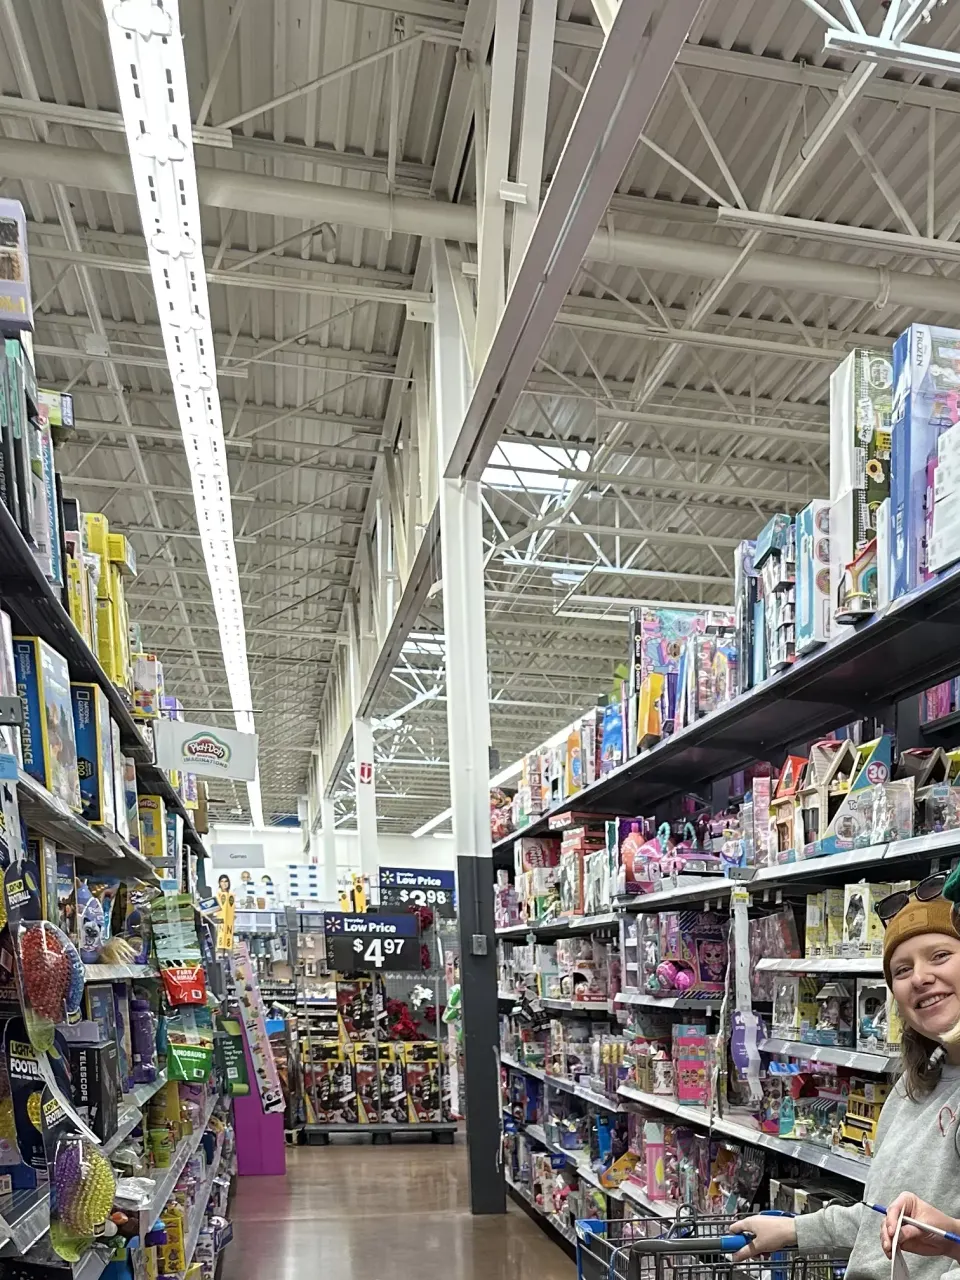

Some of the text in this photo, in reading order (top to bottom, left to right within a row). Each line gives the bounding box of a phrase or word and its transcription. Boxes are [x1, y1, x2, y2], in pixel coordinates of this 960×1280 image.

[20, 720, 34, 765] SCIENCE
[189, 742, 224, 757] Play-Doh
[183, 757, 228, 769] IMAGINATIONS
[867, 765, 888, 780] 30
[396, 876, 442, 886] Low Price
[8, 889, 31, 906] FOOTBALL
[343, 922, 397, 933] Low Price
[172, 1048, 207, 1059] DINOSAURS
[79, 1050, 88, 1102] TELESCOPE
